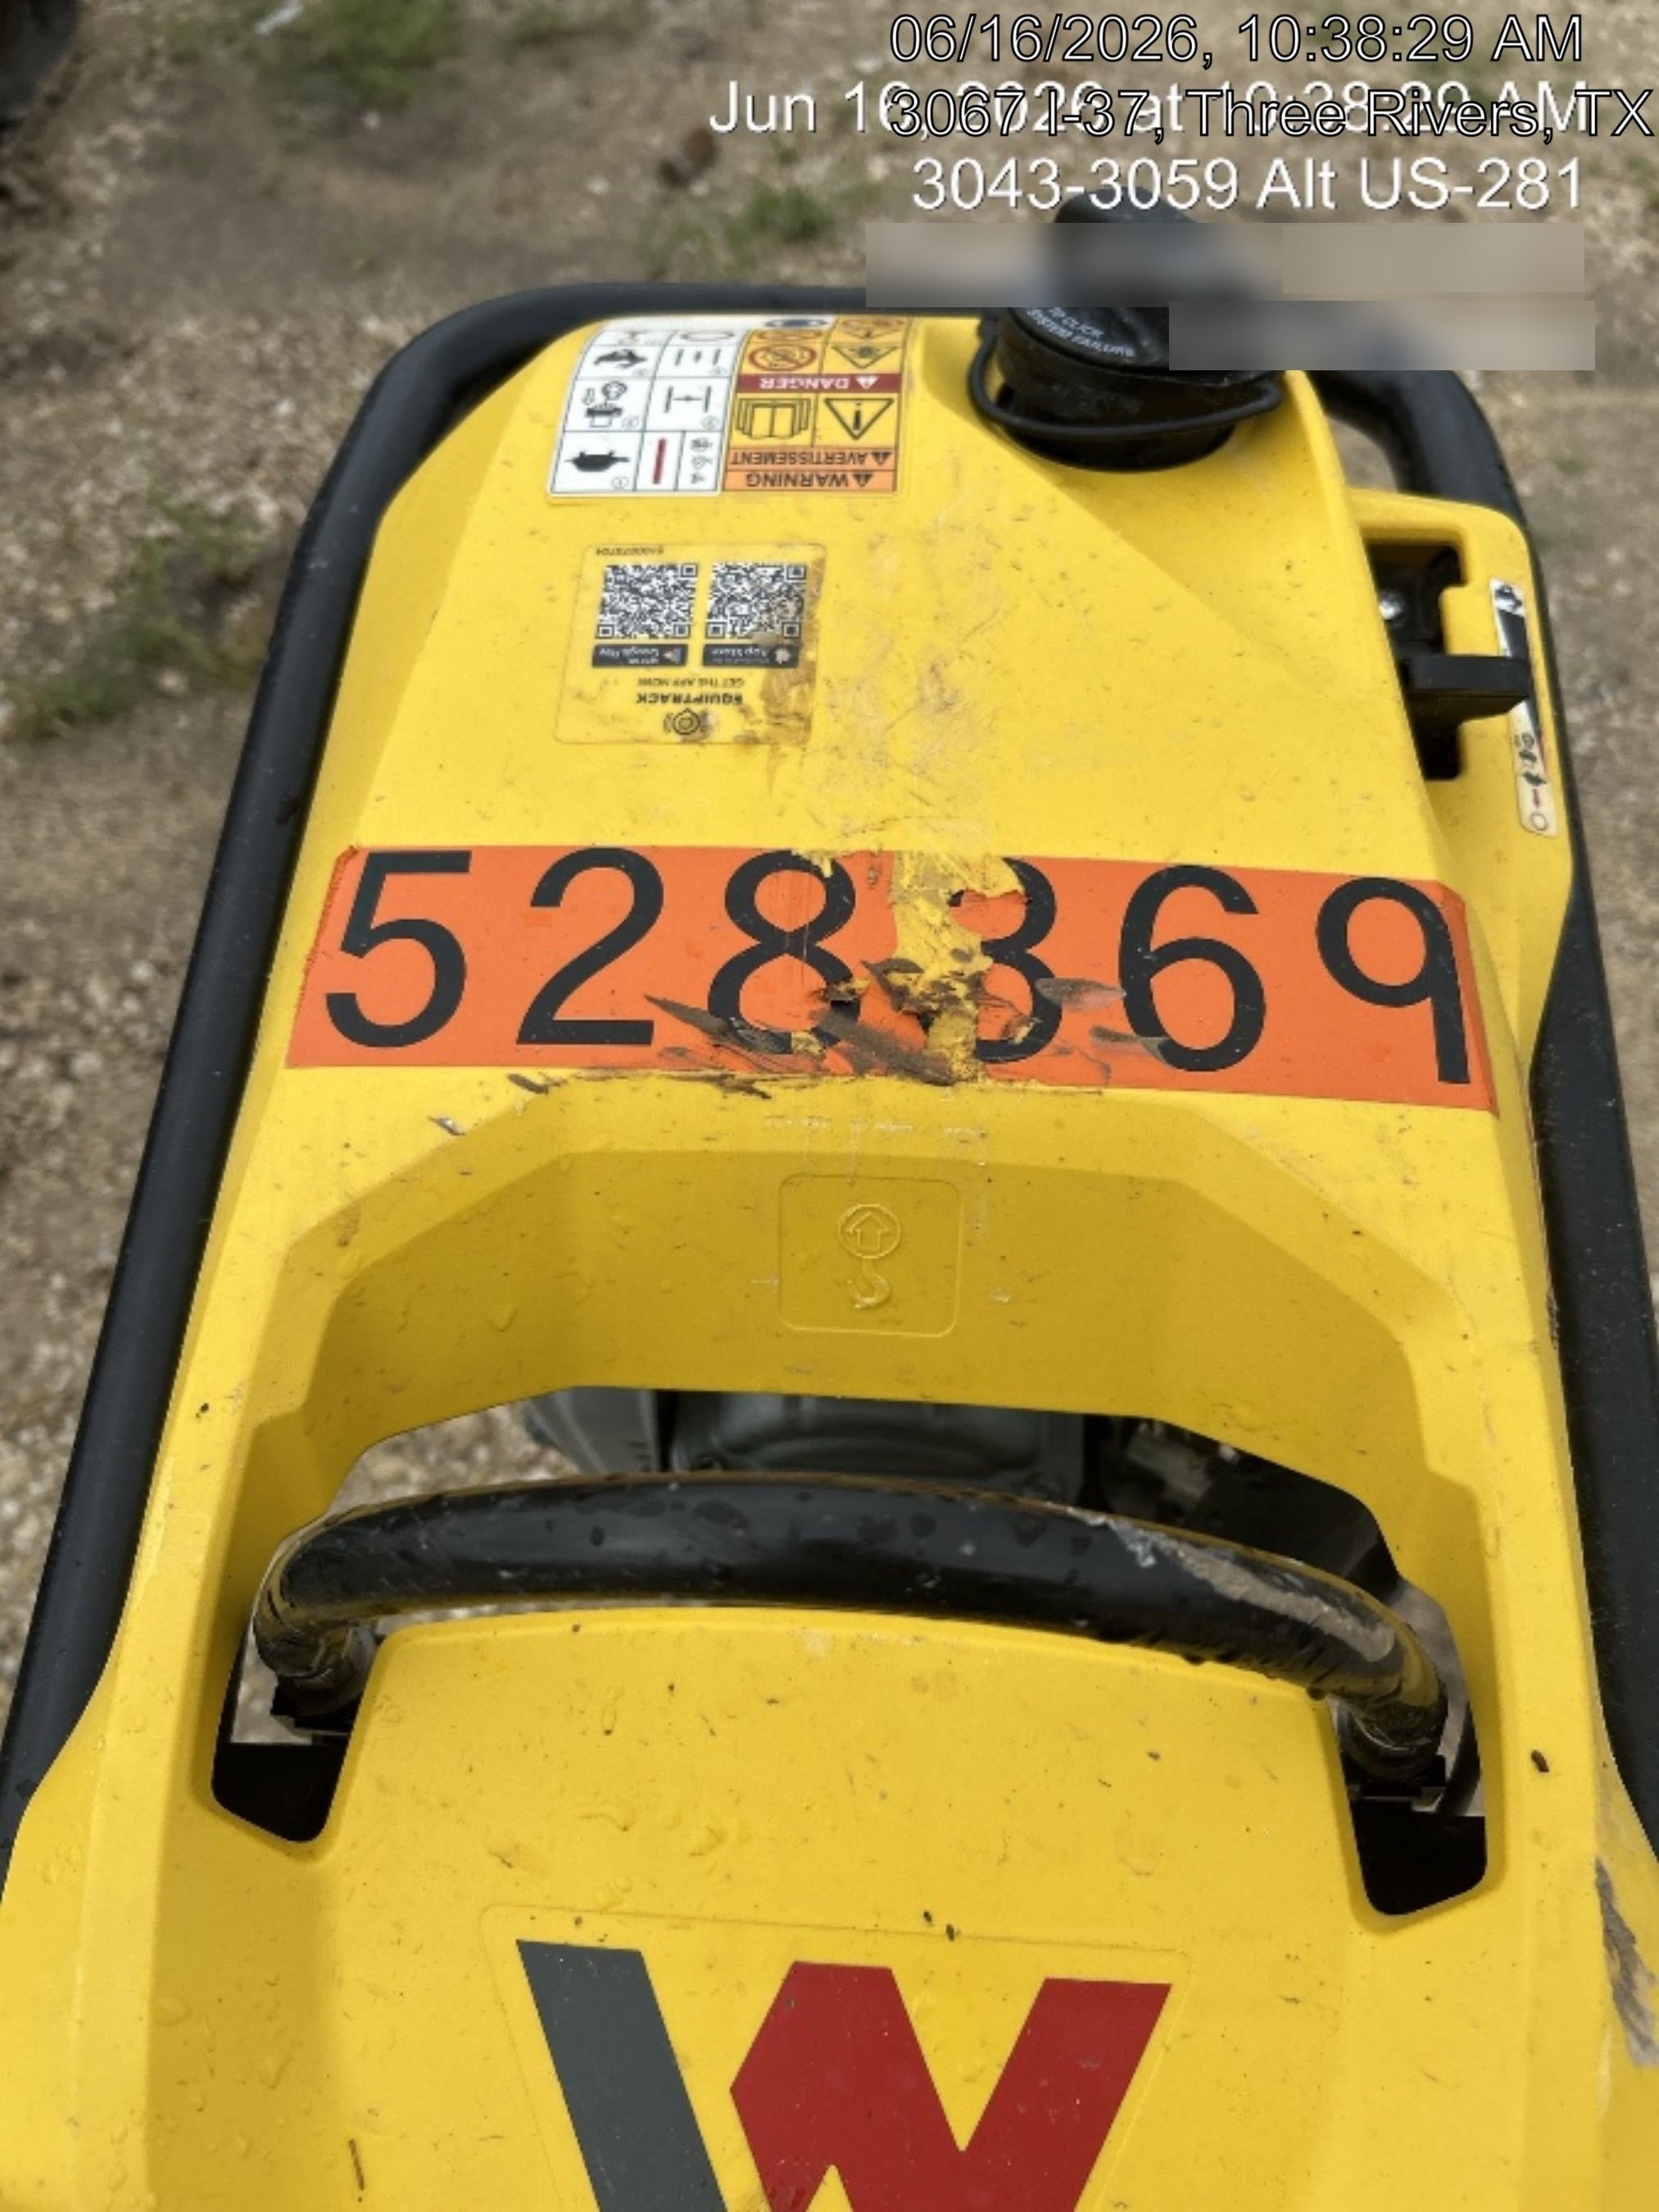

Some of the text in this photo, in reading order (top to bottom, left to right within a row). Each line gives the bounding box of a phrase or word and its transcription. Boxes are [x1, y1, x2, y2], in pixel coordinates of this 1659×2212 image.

[759, 376, 851, 390] DANGER
[731, 451, 868, 466] AVERTISSEMENT
[746, 474, 850, 487] WARNING
[636, 692, 744, 705] EQUIPTRACK
[324, 845, 1473, 1086] 528369
